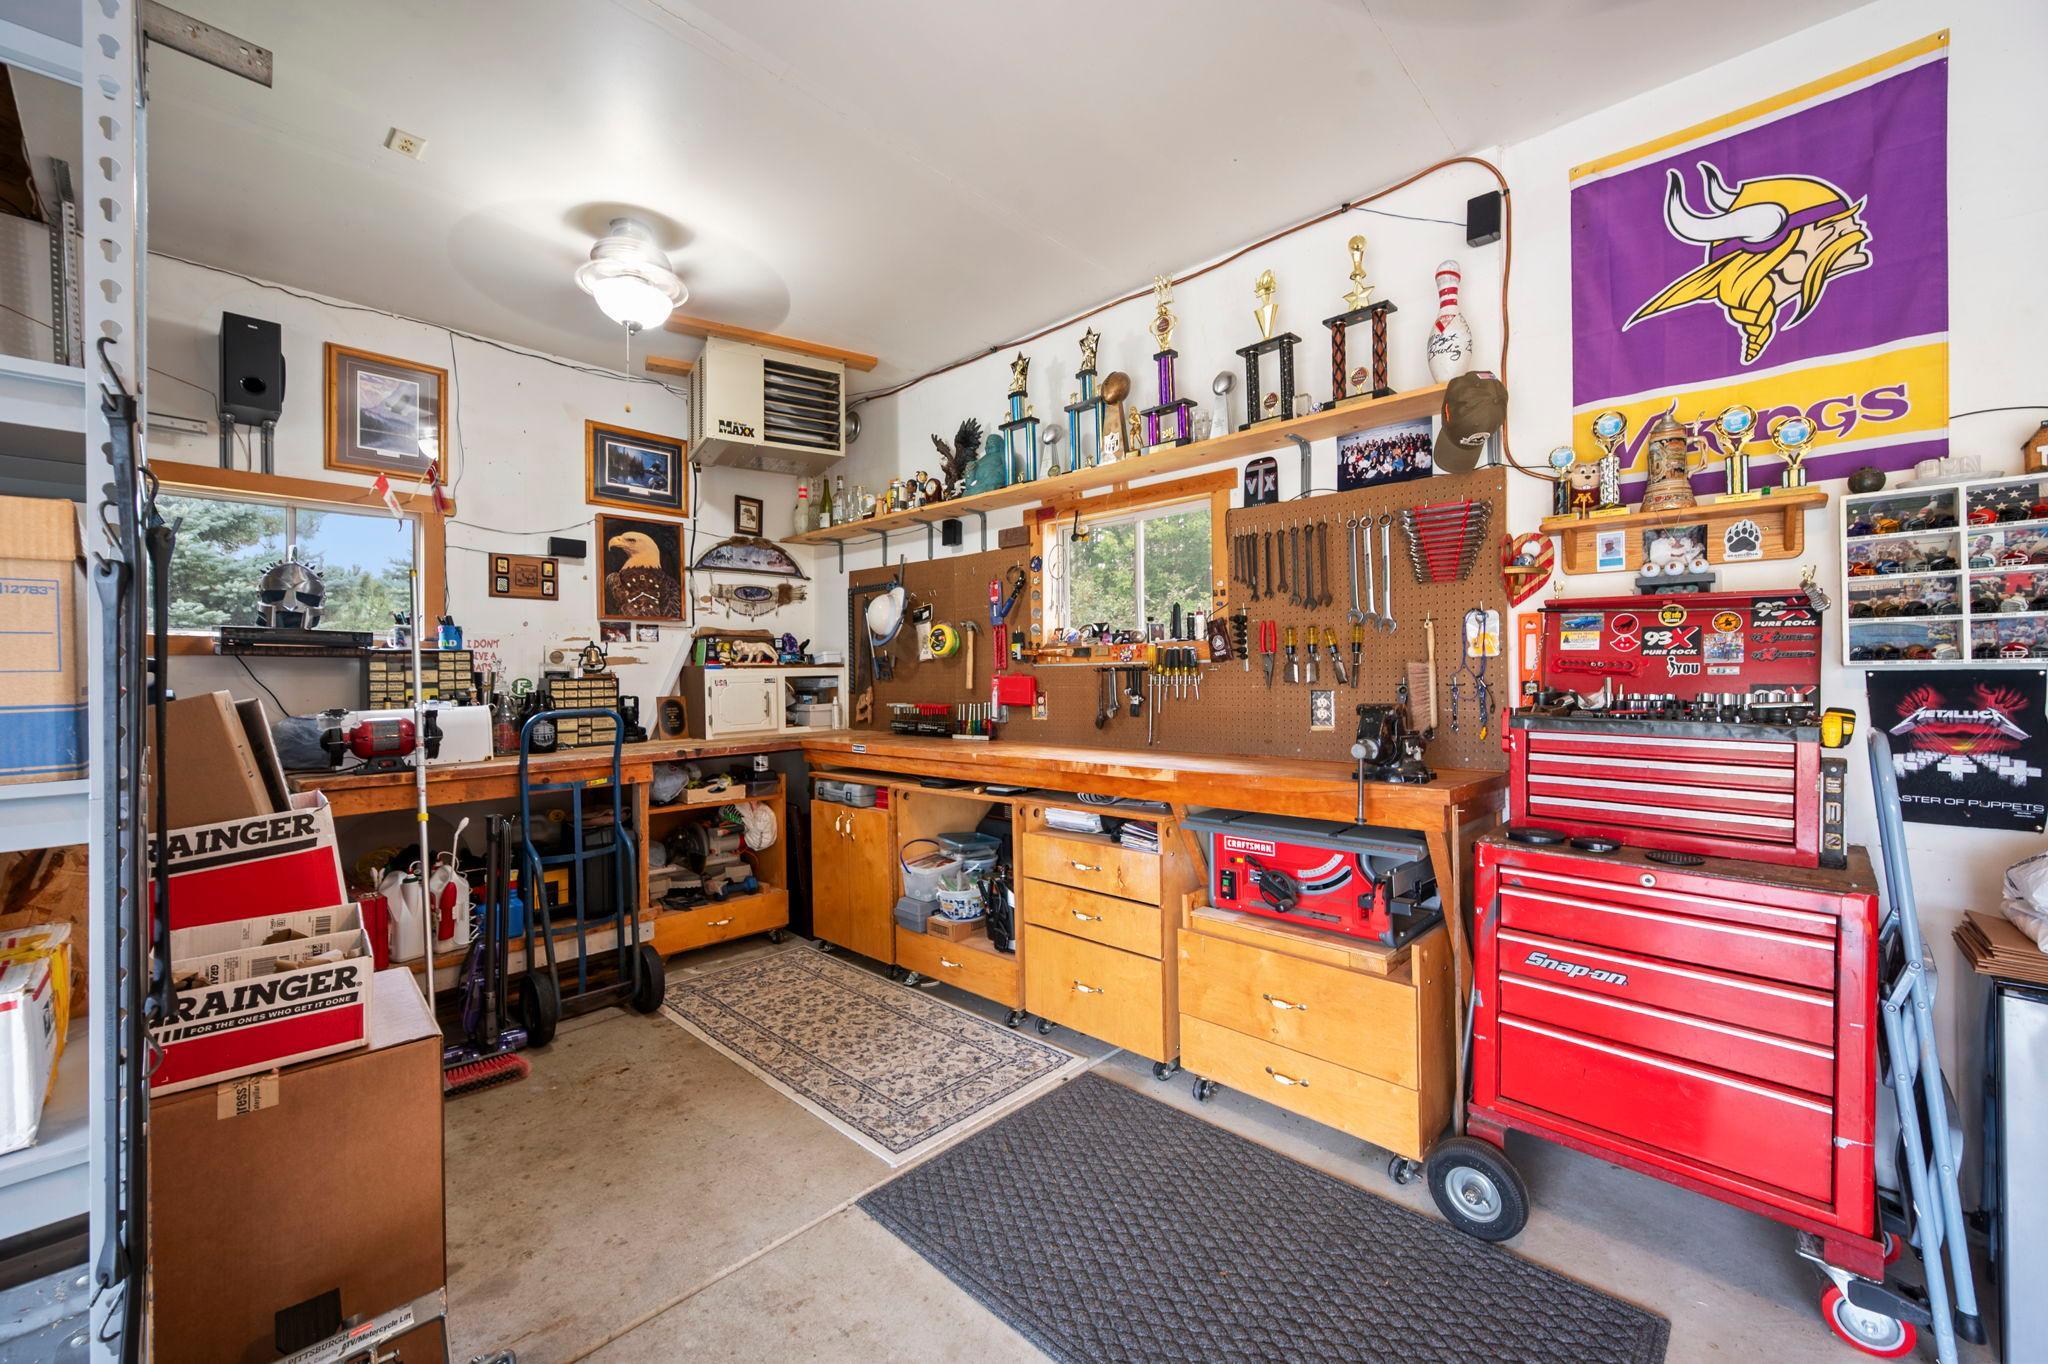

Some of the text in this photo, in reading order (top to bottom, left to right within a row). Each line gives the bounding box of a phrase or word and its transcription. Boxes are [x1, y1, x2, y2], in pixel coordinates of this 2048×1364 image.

[1644, 627, 1699, 649] 93X
[473, 652, 488, 660] IVE
[1676, 664, 1698, 674] YOU
[1889, 706, 2031, 740] METALLICA
[1968, 800, 2045, 812] PUPPETS
[1227, 839, 1273, 853] CRAFTSMAN
[1525, 951, 1627, 985] Snap-on
[190, 996, 350, 1035] FOR THE ONES WHO GET IT DONE
[399, 1312, 412, 1323] Lift
